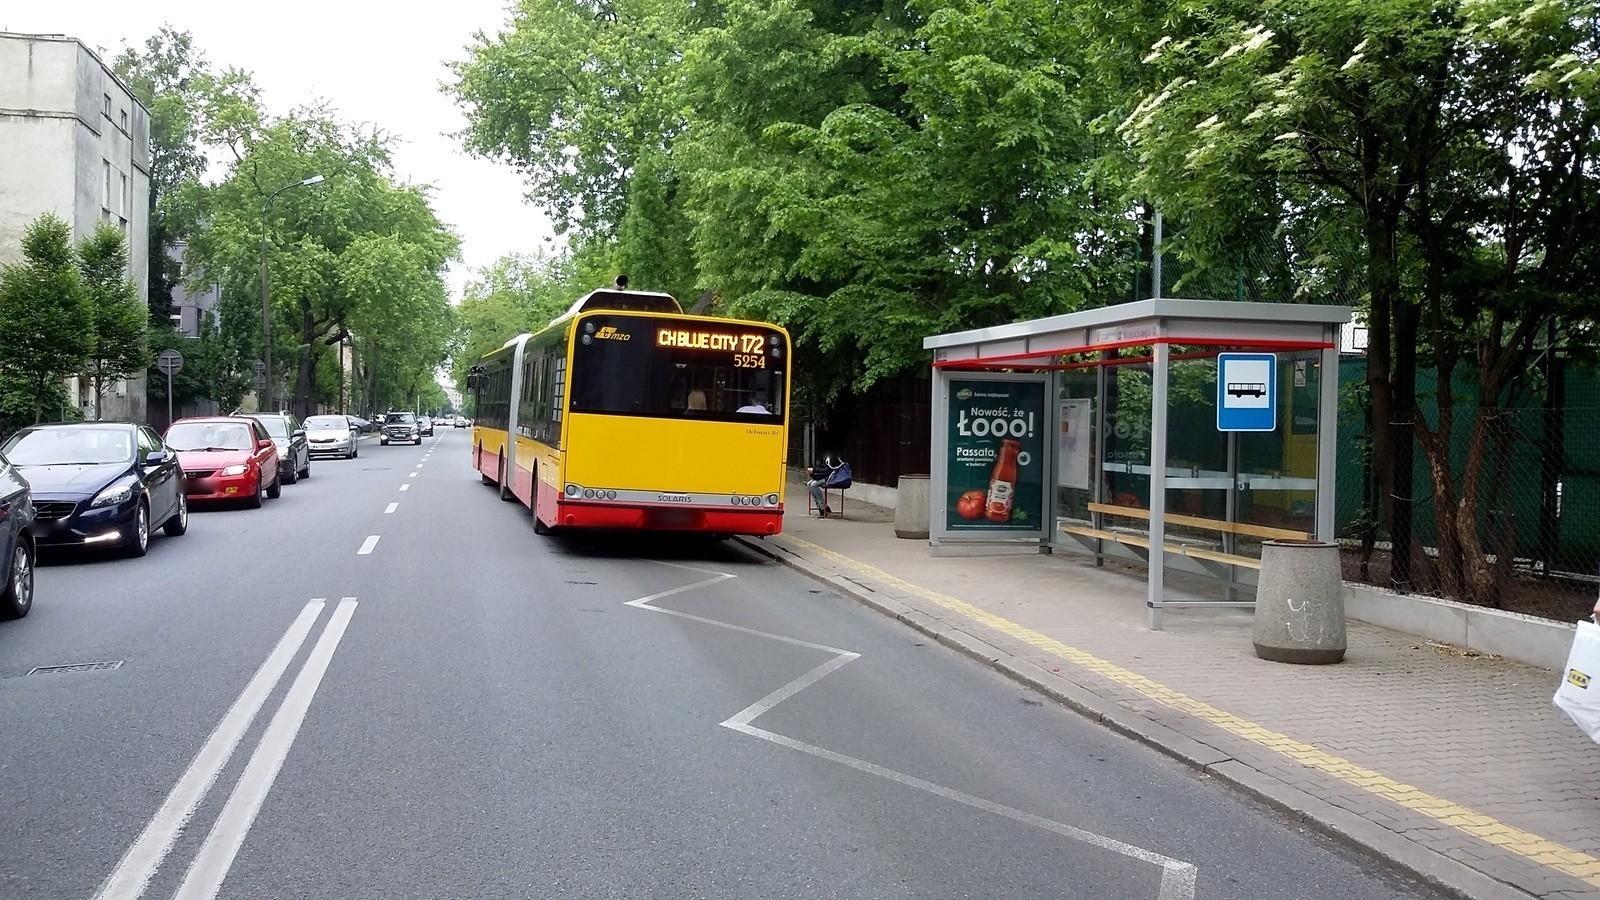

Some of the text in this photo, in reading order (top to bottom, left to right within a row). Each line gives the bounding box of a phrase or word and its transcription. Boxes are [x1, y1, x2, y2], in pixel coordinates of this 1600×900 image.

[610, 333, 631, 341] mza
[677, 331, 710, 349] BLUE
[710, 334, 739, 351] CITY
[741, 334, 765, 354] 172
[733, 354, 766, 369] 5254
[970, 406, 1025, 418] Nowość, że
[657, 495, 692, 503] SOLARIS
